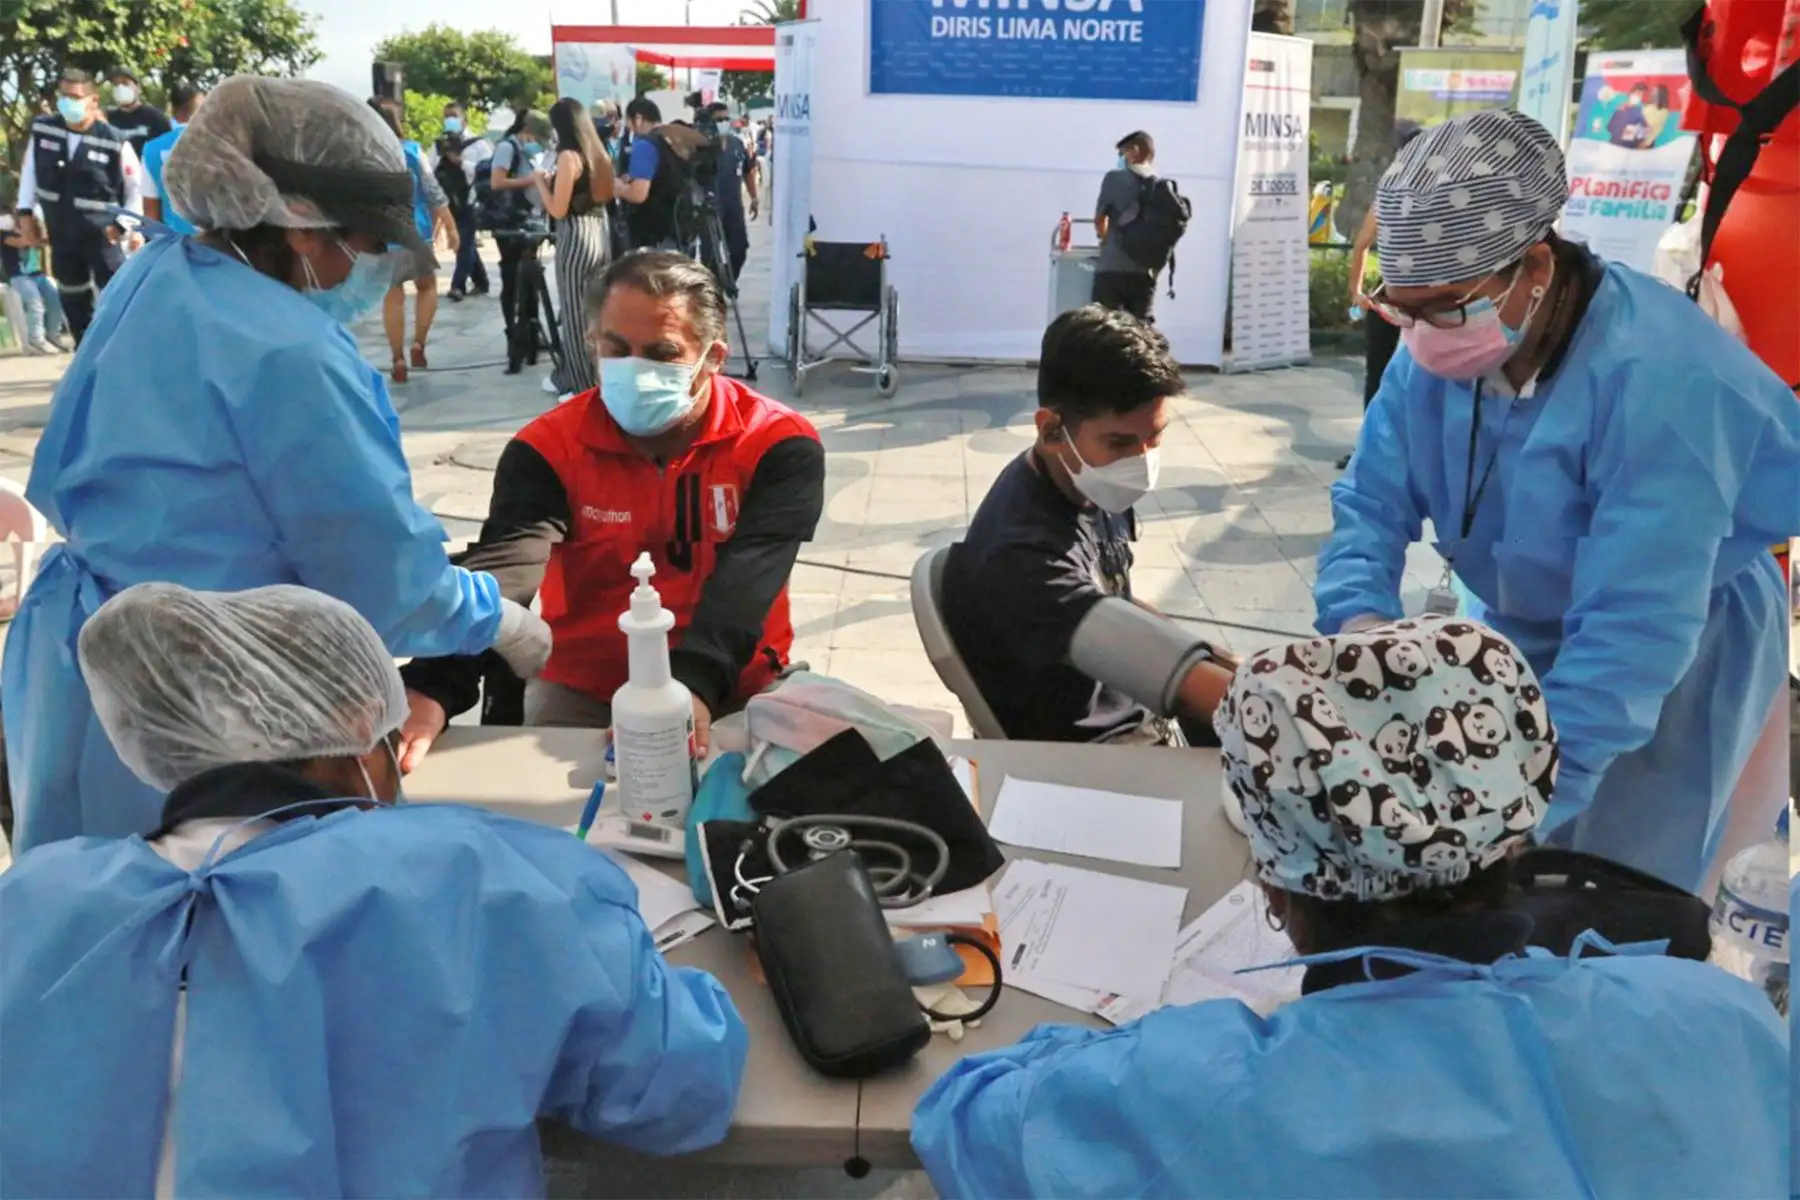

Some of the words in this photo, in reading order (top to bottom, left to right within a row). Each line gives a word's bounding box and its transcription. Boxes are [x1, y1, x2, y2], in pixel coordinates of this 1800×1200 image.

[931, 15, 991, 38] DIRIS
[996, 17, 1058, 41] LIMA
[1063, 18, 1144, 42] NORTE
[777, 93, 811, 121] MNSA
[1244, 111, 1303, 138] MINSA
[922, 937, 937, 949] 2
